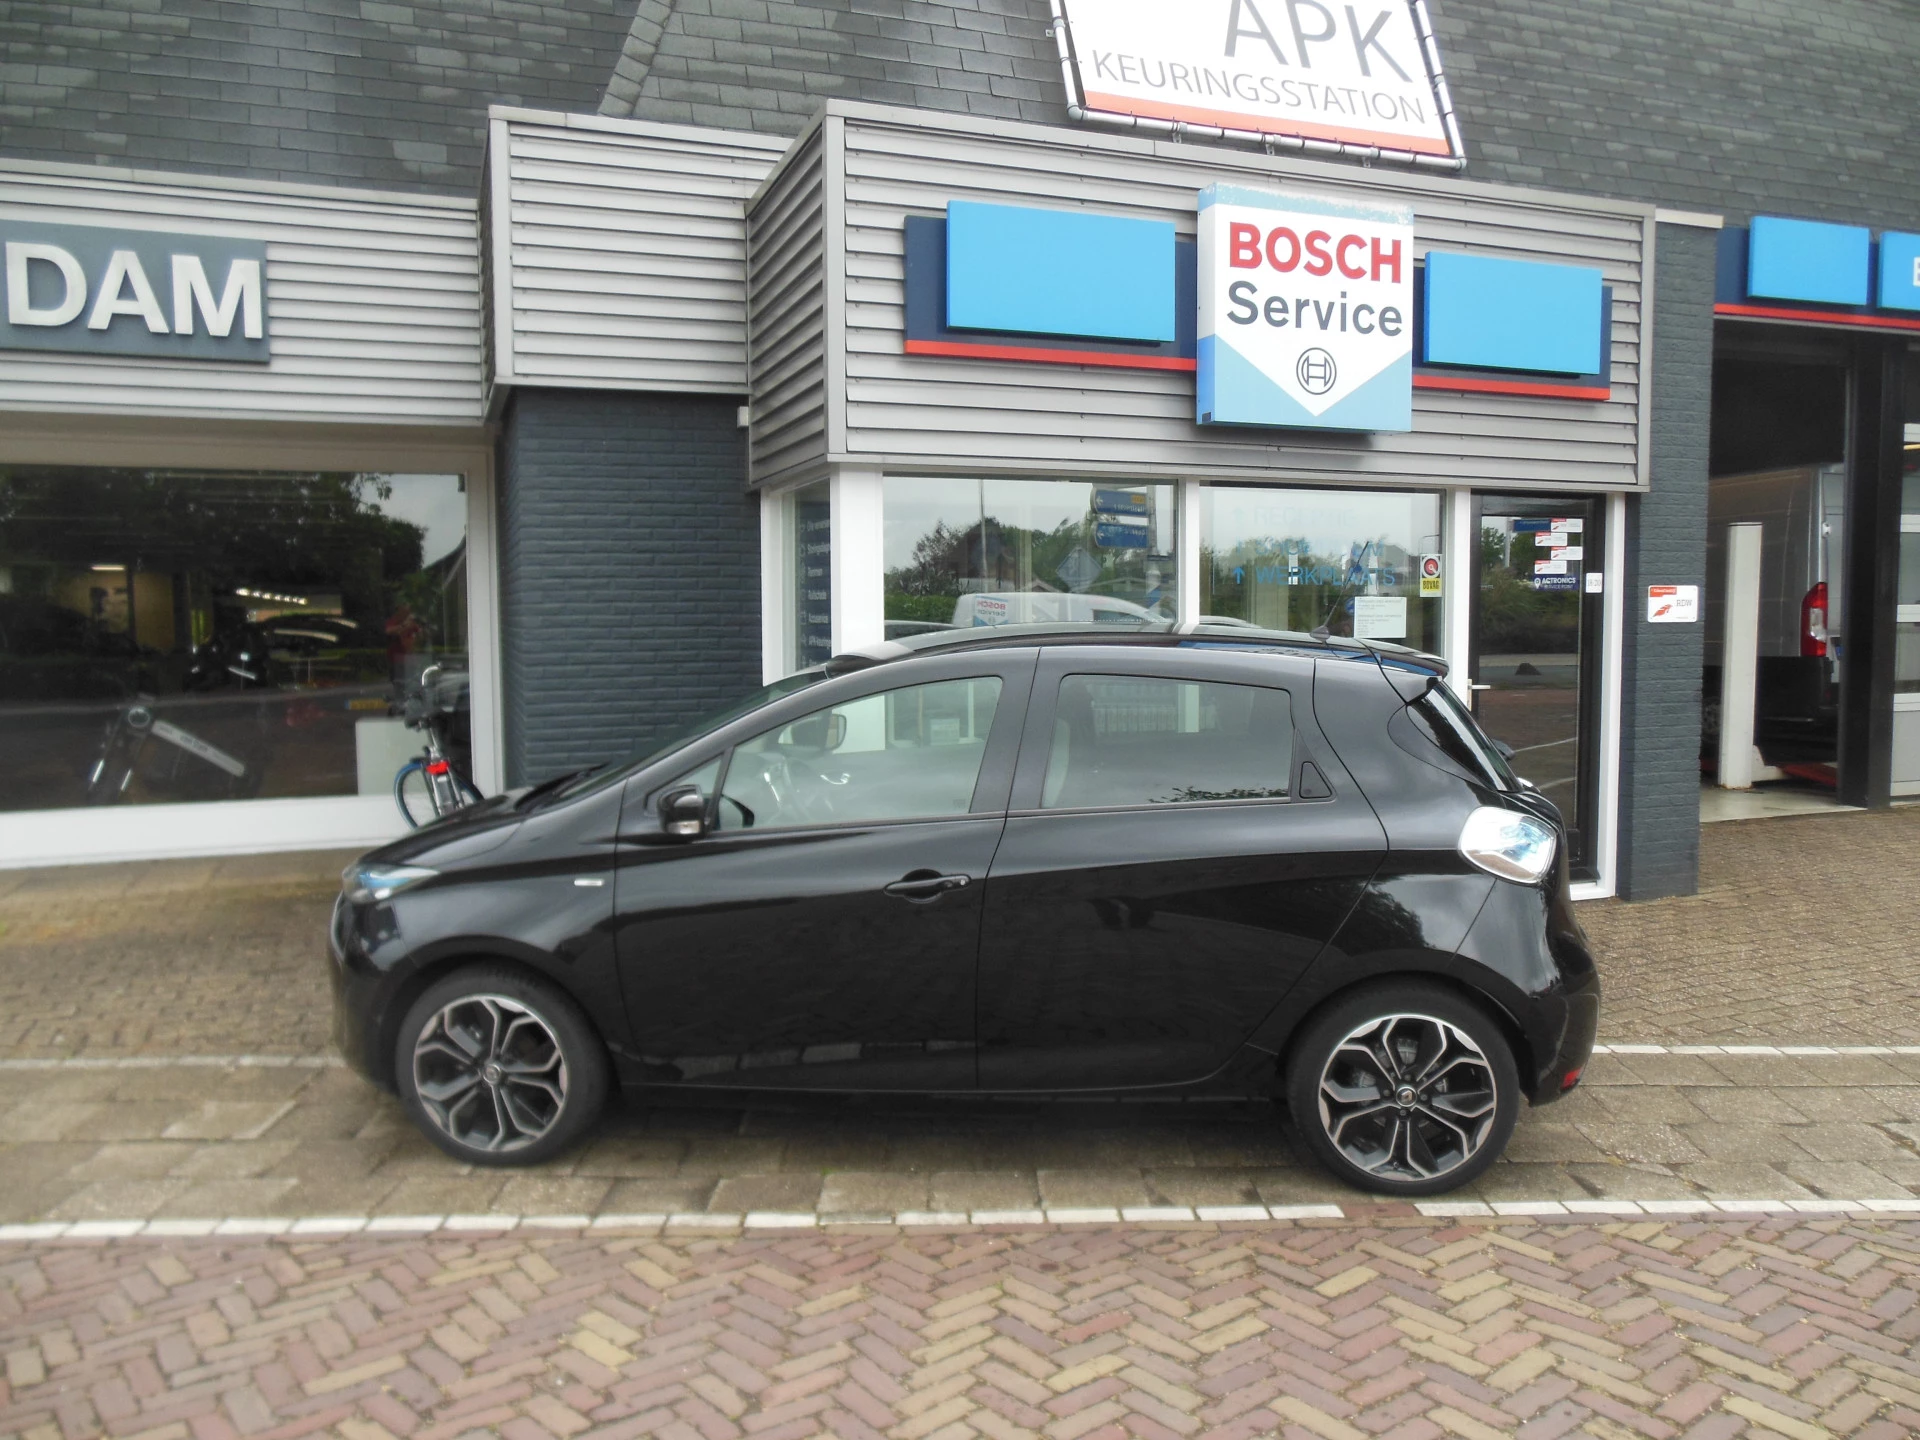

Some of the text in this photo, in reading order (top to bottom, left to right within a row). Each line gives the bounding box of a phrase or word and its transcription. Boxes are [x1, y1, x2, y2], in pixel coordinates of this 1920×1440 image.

[1224, 0, 1413, 83] APK
[1093, 49, 1425, 125] KEURINGSSTATION
[1229, 221, 1402, 284] BOSCH
[5, 241, 263, 339] DAM
[1226, 280, 1403, 337] Service
[1255, 566, 1396, 586] WERKPLAATS
[1541, 577, 1577, 585] ACTRONICS
[1676, 599, 1693, 607] RDW
